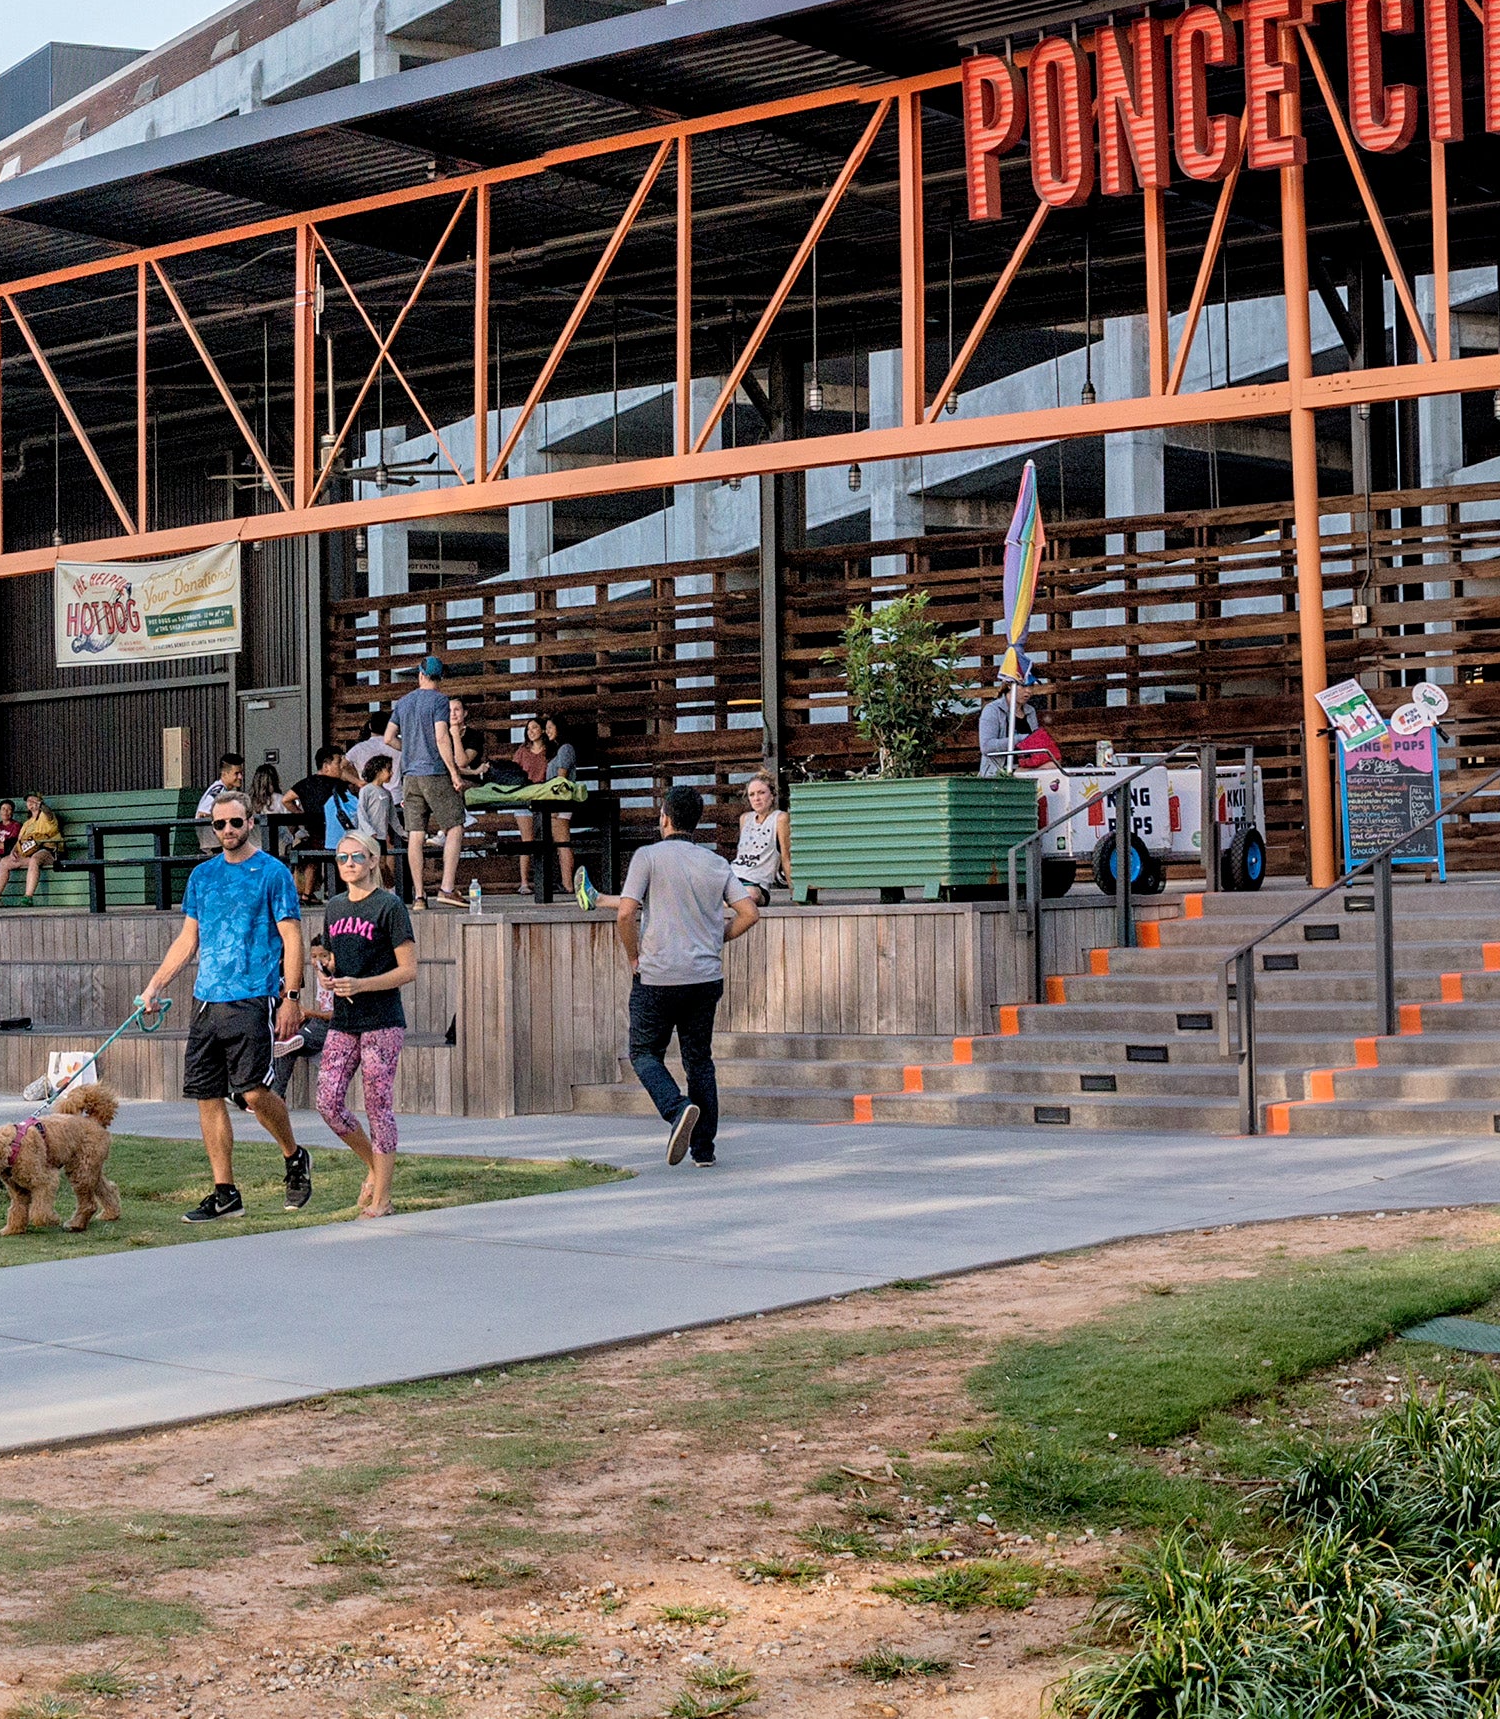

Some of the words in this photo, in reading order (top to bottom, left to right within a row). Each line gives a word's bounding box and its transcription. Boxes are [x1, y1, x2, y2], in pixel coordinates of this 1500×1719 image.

[72, 574, 88, 598] THE
[143, 586, 170, 612] Your
[172, 559, 234, 596] Donations!
[1404, 708, 1418, 717] KING
[1407, 713, 1422, 724] POPS
[1394, 741, 1425, 751] POPS
[1107, 787, 1151, 808] KNG
[1108, 816, 1152, 835] PPS
[329, 916, 375, 940] MIAMI
